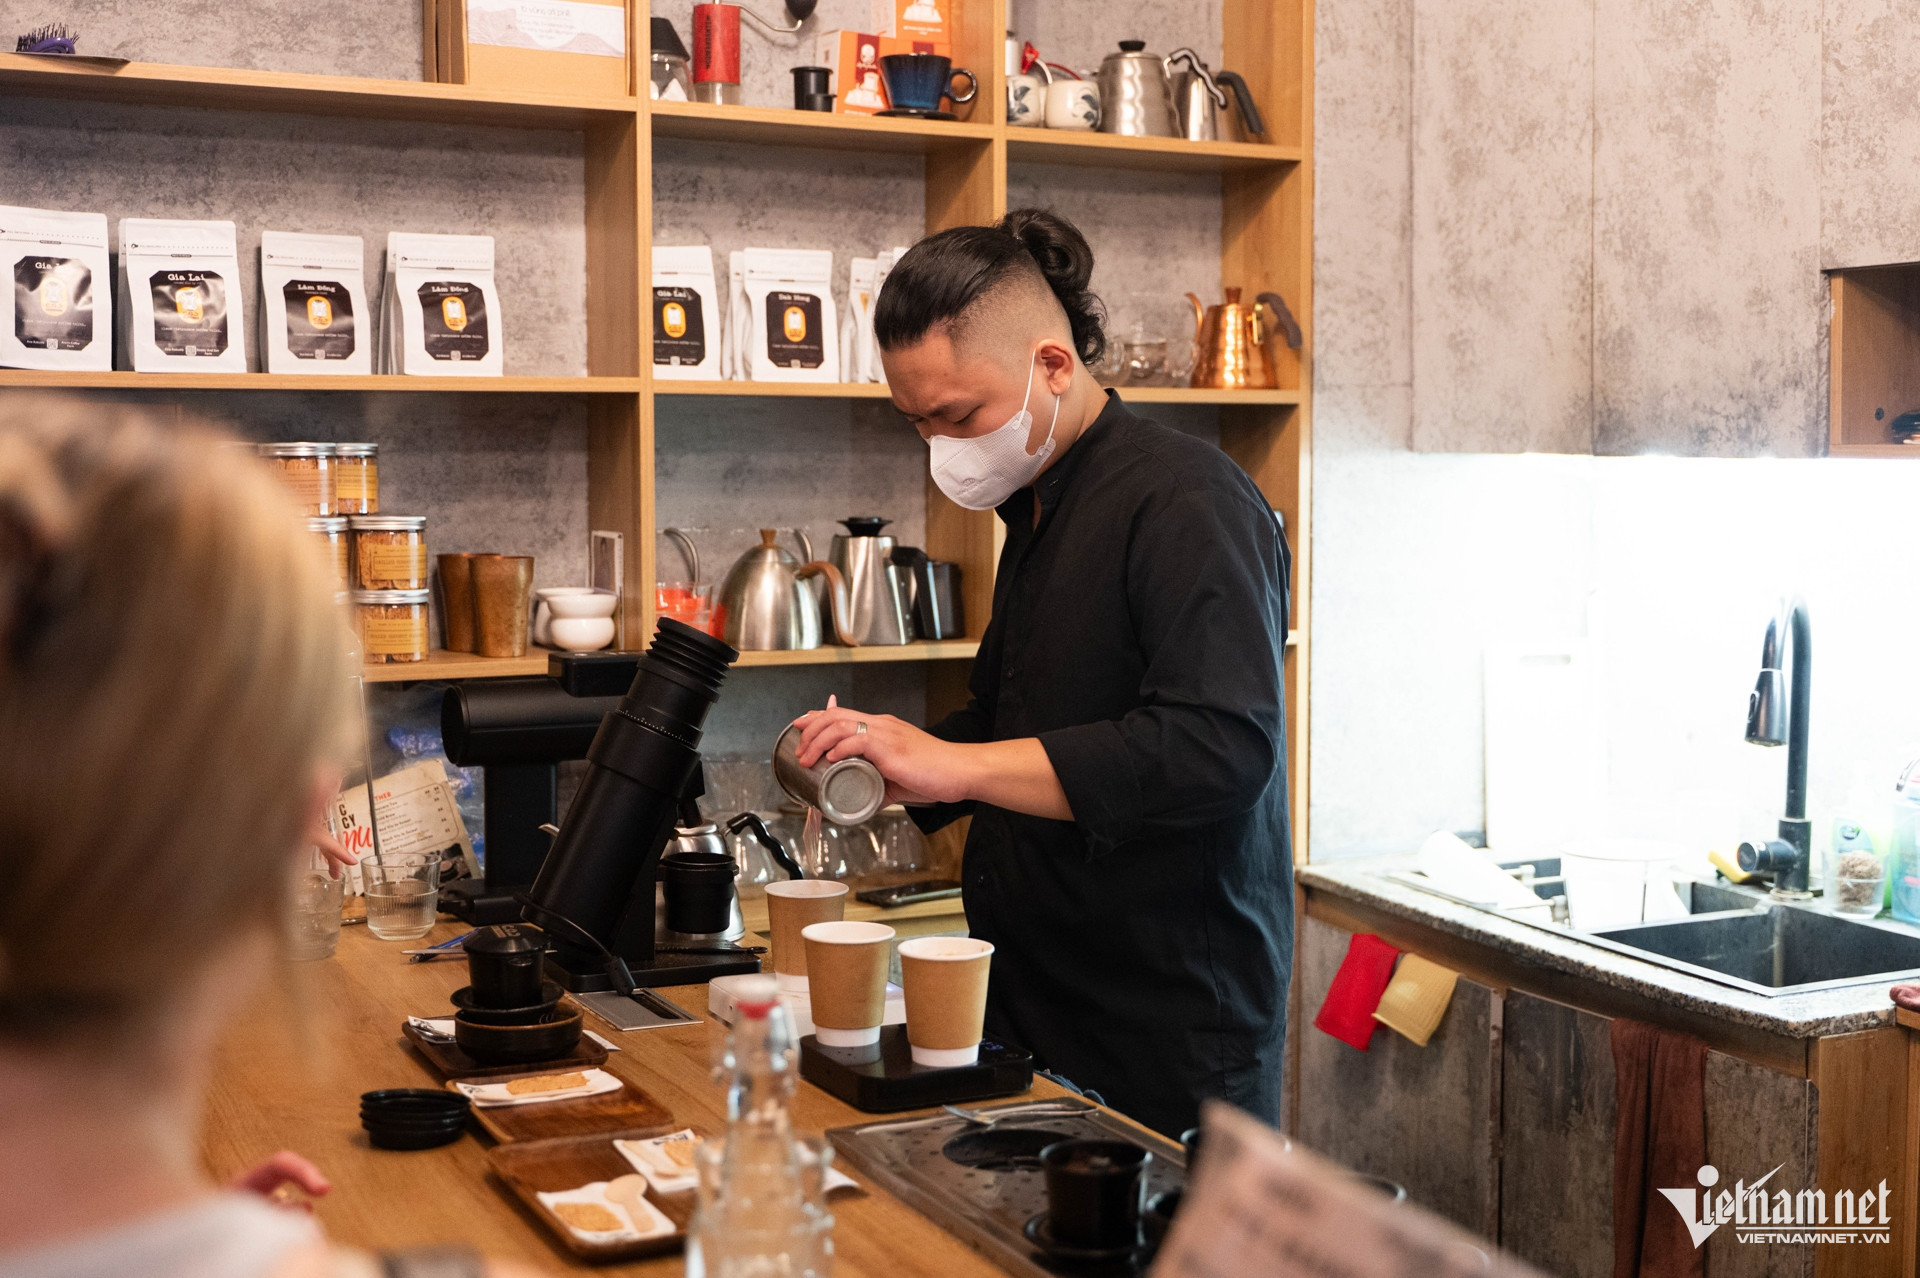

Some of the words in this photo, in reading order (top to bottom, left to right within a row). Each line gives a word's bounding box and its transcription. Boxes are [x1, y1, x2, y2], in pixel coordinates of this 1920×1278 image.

[34, 261, 53, 270] Gia
[167, 273, 186, 281] Gia
[188, 273, 205, 282] Lai
[656, 289, 673, 298] Gia
[673, 289, 687, 298] Lai
[374, 791, 392, 801] THER
[338, 804, 347, 817] C
[342, 814, 357, 829] CY
[343, 826, 373, 855] nu
